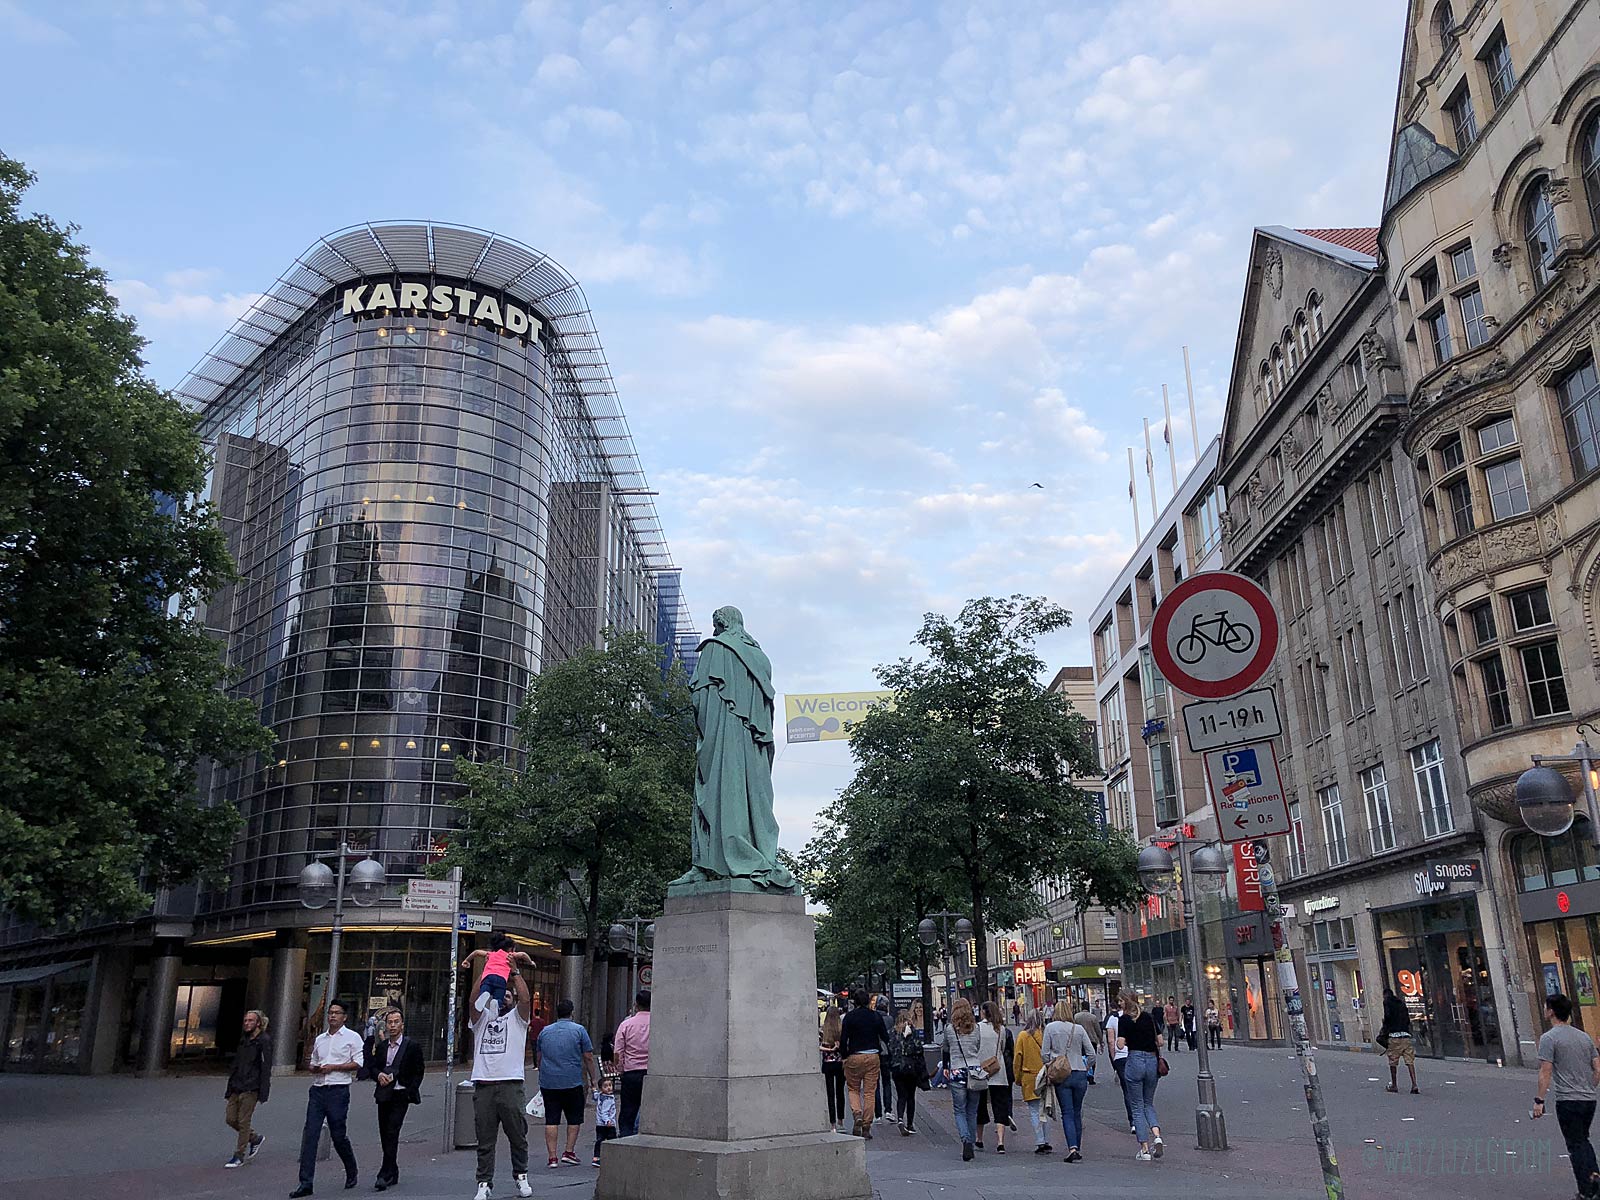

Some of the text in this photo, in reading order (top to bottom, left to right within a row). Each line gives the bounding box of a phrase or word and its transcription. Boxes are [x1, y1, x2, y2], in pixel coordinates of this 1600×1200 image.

[343, 282, 543, 344] KARSTADT
[795, 697, 890, 714] Welcom
[1199, 705, 1265, 735] 11-19 h
[1226, 754, 1240, 771] P
[1241, 841, 1262, 898] SPRIT
[1435, 864, 1472, 880] snipes
